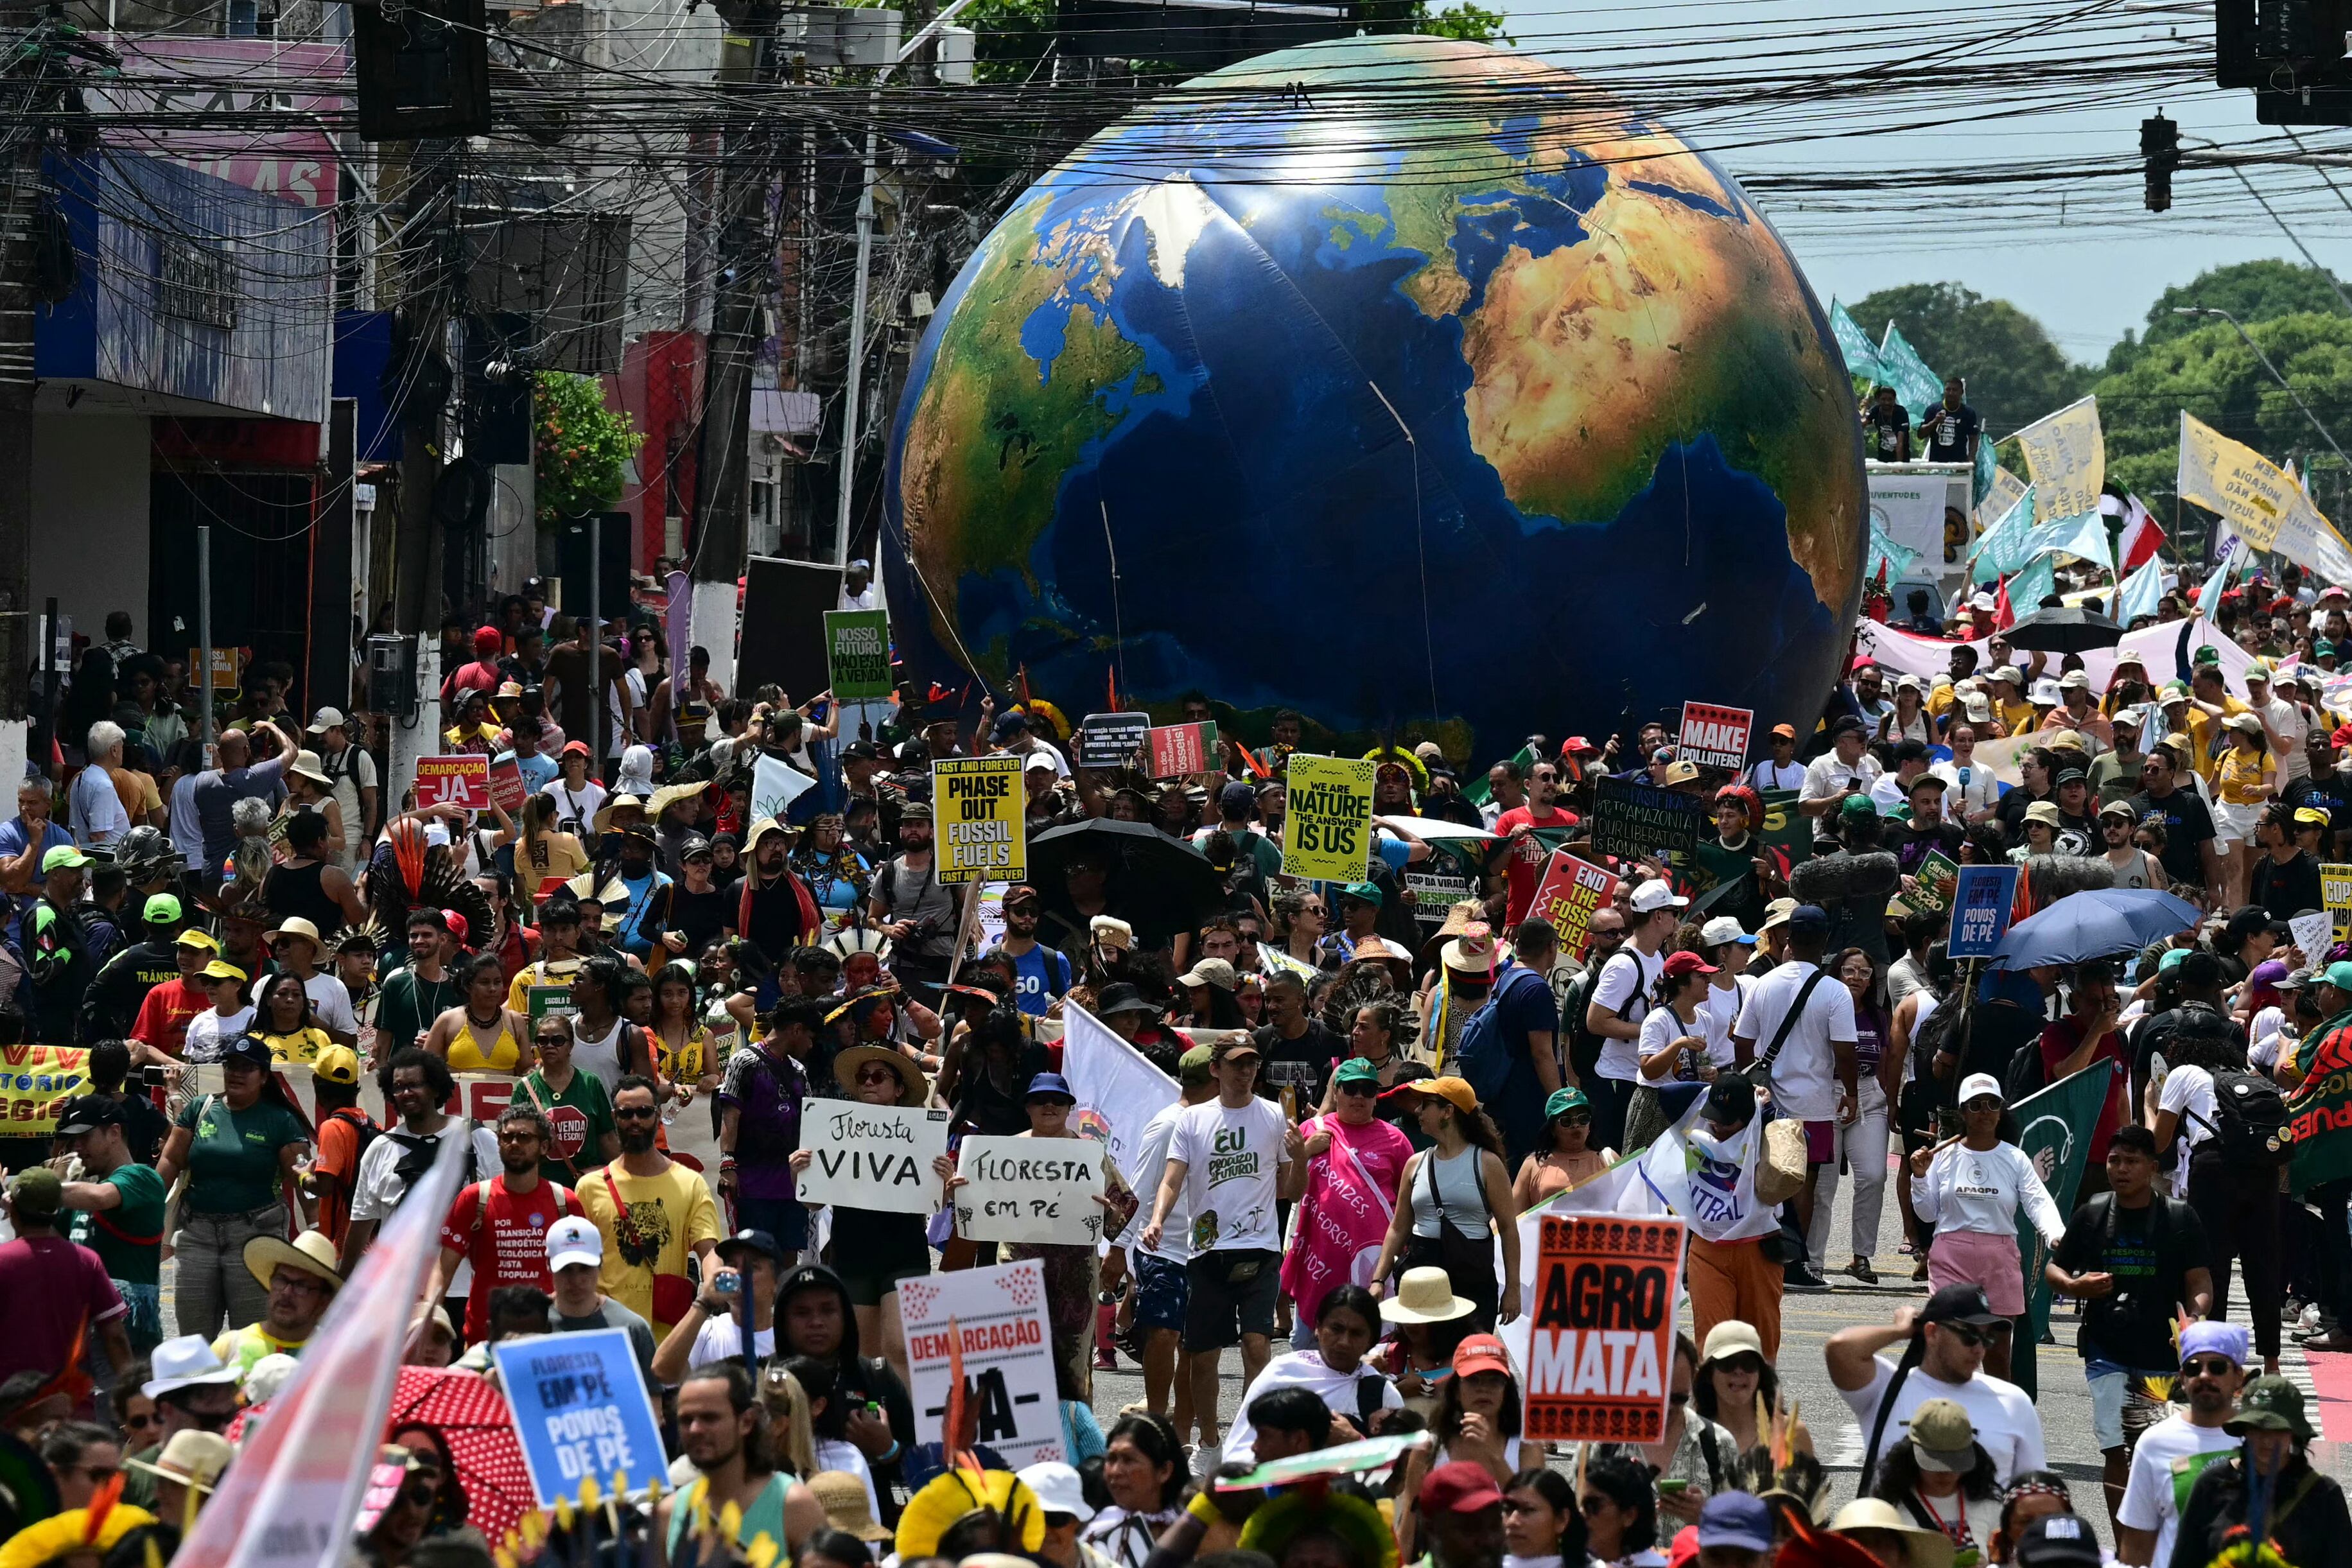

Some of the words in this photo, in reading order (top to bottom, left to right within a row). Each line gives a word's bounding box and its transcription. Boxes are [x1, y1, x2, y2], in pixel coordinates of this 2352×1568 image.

[836, 627, 878, 641] NOSSO
[212, 650, 225, 660] SSA
[835, 641, 882, 656] FUTURO
[196, 660, 231, 672] AZÔNIA
[832, 654, 858, 670] NÃO
[859, 650, 887, 668] ESTÁ
[847, 669, 886, 683] VENDA
[1683, 720, 1746, 753] MAKE
[1166, 729, 1174, 774] combustíveis
[1172, 727, 1187, 773] fósseis!
[1680, 747, 1741, 769] POLLUTERS
[419, 762, 486, 777] DEMARCAÇÃO
[937, 762, 958, 773] FAST
[961, 760, 979, 772] AND
[980, 759, 1020, 771] FOREVER
[433, 774, 469, 802] JÁ
[493, 781, 523, 799] sseis!
[948, 775, 1009, 798] PHASE
[1311, 781, 1327, 792] WE
[1329, 782, 1350, 794] ARE
[1600, 783, 1632, 802] FROM
[1632, 785, 1684, 809] PASIFIKA
[961, 798, 998, 821] OUT
[1290, 788, 1370, 819] NATURE
[1294, 812, 1313, 823] THE
[1316, 814, 1361, 828] ANSWER
[1614, 801, 1625, 812] TO
[1626, 806, 1693, 830] AMAZONIA
[948, 820, 1013, 844] FOSSIL
[1297, 823, 1320, 851] IS
[1324, 826, 1355, 855] US
[1598, 817, 1625, 837] OUR
[1625, 823, 1693, 849] LIBERATION
[953, 844, 1009, 867] FUELS
[1593, 838, 1603, 849] IS
[1607, 839, 1650, 858] BOUND
[941, 871, 962, 882] FAST
[964, 869, 980, 881] AN
[988, 867, 1024, 880] OREVER
[1407, 875, 1424, 885] COP
[1425, 876, 1436, 886] DA
[1438, 877, 1465, 888] VIRAD
[1575, 866, 1607, 893] END
[1972, 876, 2001, 887] FLORESTA
[2321, 867, 2327, 875] DE
[2336, 867, 2348, 876] LADO
[1571, 883, 1601, 910] THE
[1967, 888, 1983, 904] EM
[1986, 887, 1999, 904] PÉ
[1549, 896, 1591, 930] FOSS
[1964, 908, 1996, 923] POVOS
[2327, 907, 2352, 926] MBI
[1961, 924, 1976, 942] DE
[1978, 923, 1994, 942] PÉ
[1015, 975, 1040, 994] 50
[546, 1006, 577, 1015] TERRITÓRIO
[4, 1045, 84, 1071] VIV
[557, 1120, 585, 1132] VENDA
[830, 1110, 915, 1144] Floresta
[1215, 1126, 1245, 1153] EU
[817, 1147, 921, 1186] VIVA
[971, 1150, 1091, 1181] FLORESTA
[1209, 1152, 1252, 1175] PRODUZO
[984, 1198, 1020, 1218] EM
[1029, 1192, 1062, 1218] PÉ
[494, 1219, 511, 1227] POR
[495, 1227, 543, 1239] TRANSIÇÃO
[496, 1238, 546, 1248] ENERGÉTICA
[497, 1248, 542, 1258] ECOLÓGICA
[498, 1260, 521, 1268] JUSTA
[1538, 1262, 1664, 1330] AGRO
[531, 1351, 604, 1376] FLORESTA
[1530, 1330, 1663, 1397] MATA
[538, 1372, 575, 1409] EM
[581, 1366, 614, 1401] PÉ
[545, 1405, 624, 1444] POVOS
[555, 1438, 597, 1480] DE
[595, 1433, 636, 1472] PÉ
